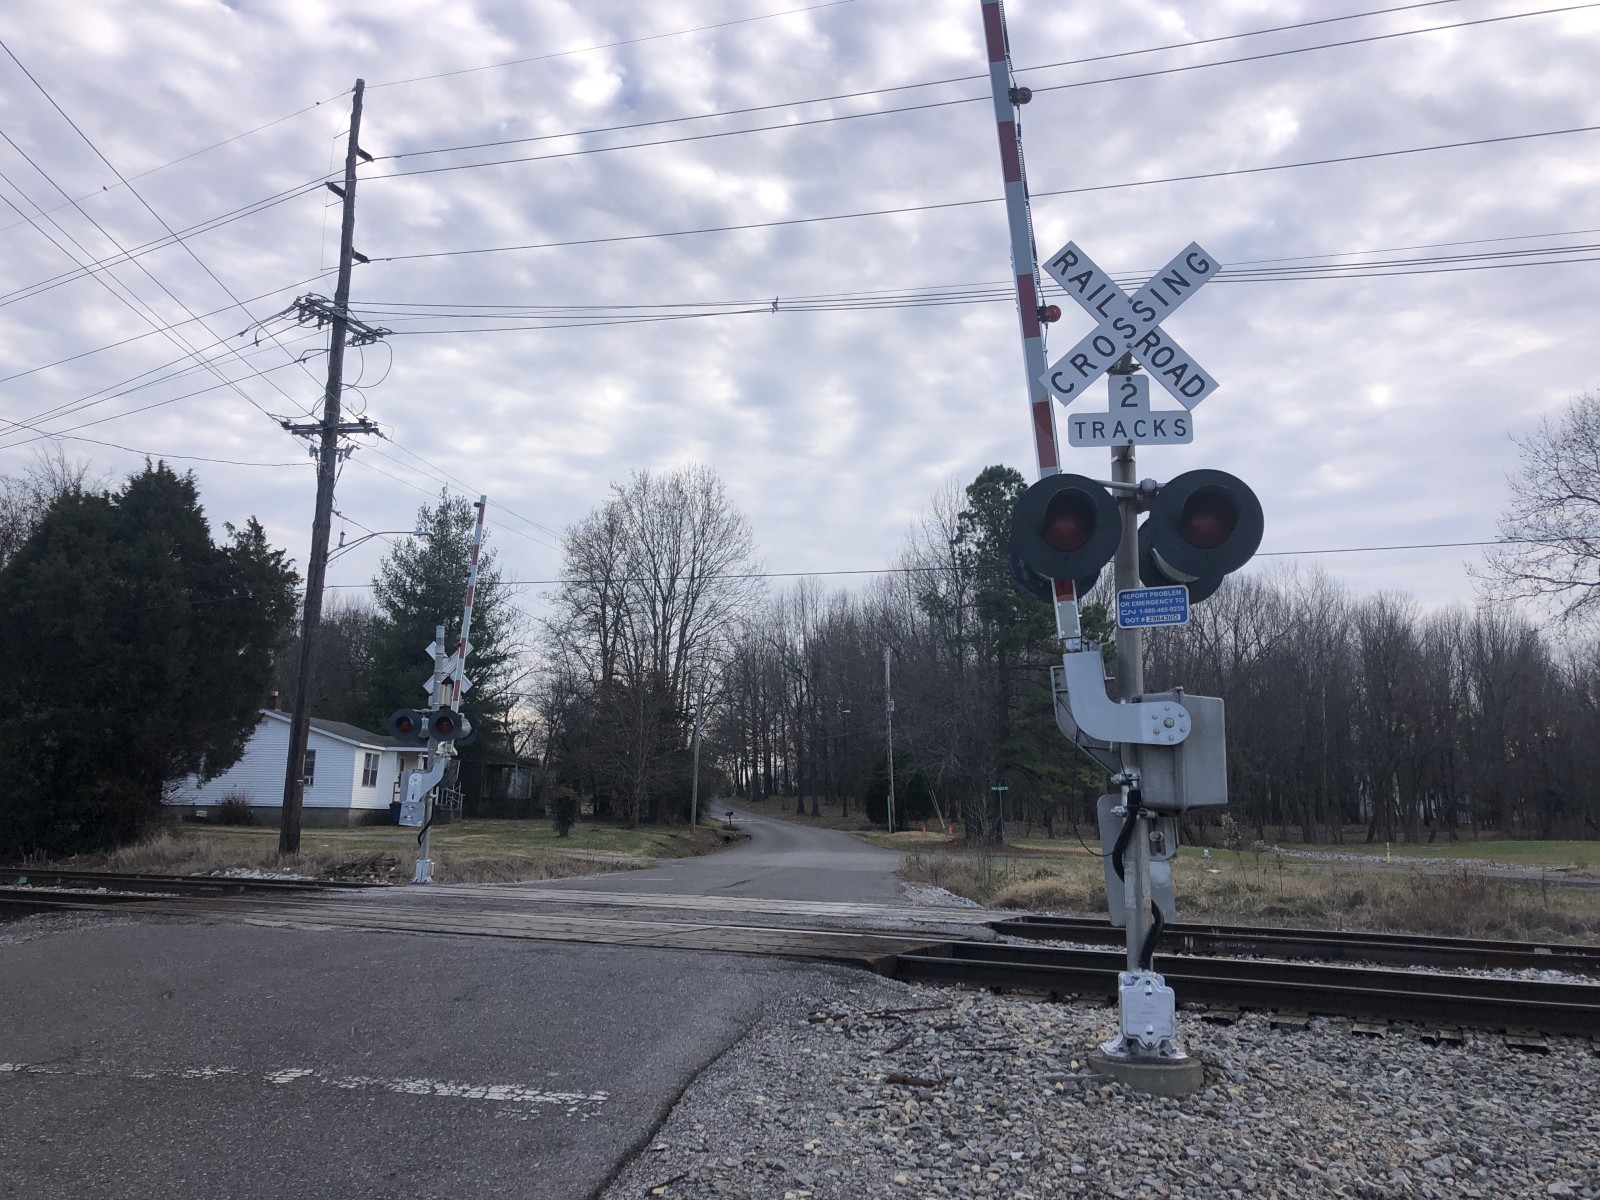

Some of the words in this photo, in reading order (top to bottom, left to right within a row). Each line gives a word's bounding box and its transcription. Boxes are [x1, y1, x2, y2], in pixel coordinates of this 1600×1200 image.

[1050, 252, 1210, 394] CROSSING
[1120, 383, 1138, 408] 2
[1074, 418, 1187, 440] TRACKS
[1132, 598, 1173, 607] EMERGENCY
